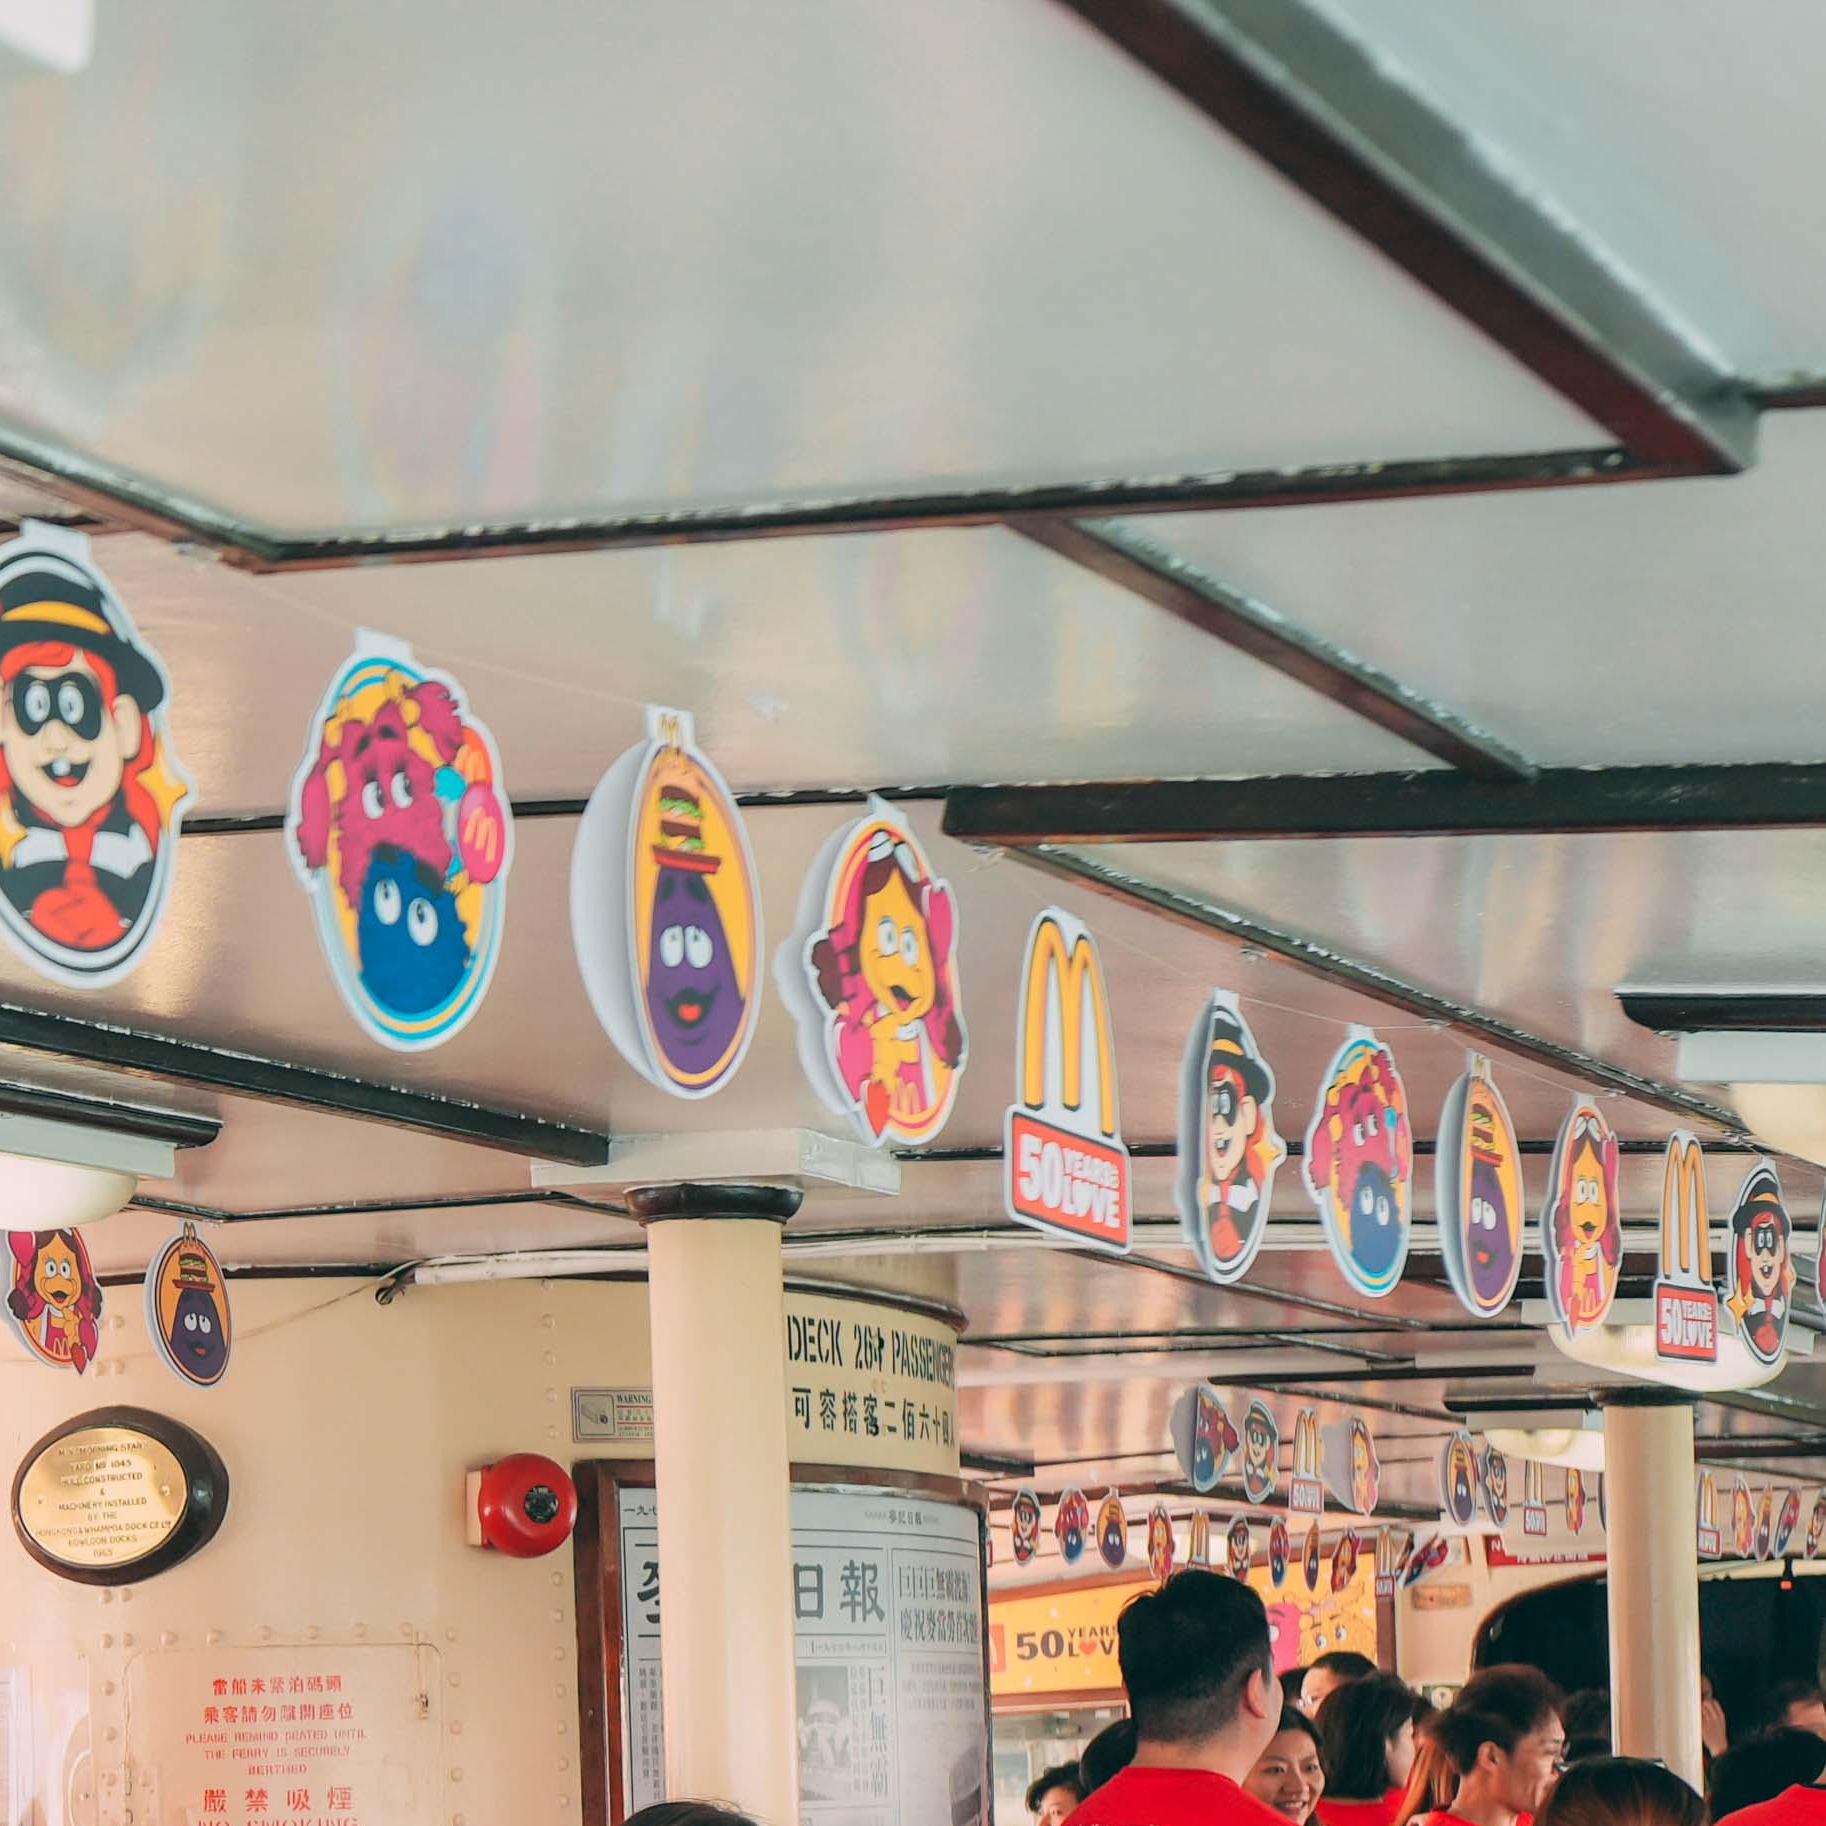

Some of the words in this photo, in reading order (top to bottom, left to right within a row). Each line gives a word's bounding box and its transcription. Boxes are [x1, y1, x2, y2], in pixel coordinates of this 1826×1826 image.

[1020, 1133, 1063, 1208] 50
[1661, 1297, 1683, 1345] 50
[787, 1315, 843, 1367] DECK
[1016, 1629, 1064, 1660] 50
[204, 1749, 225, 1761] THE
[232, 1747, 269, 1760] FERRY
[277, 1746, 288, 1758] IS
[204, 1786, 354, 1814] 嚴禁吸煙
